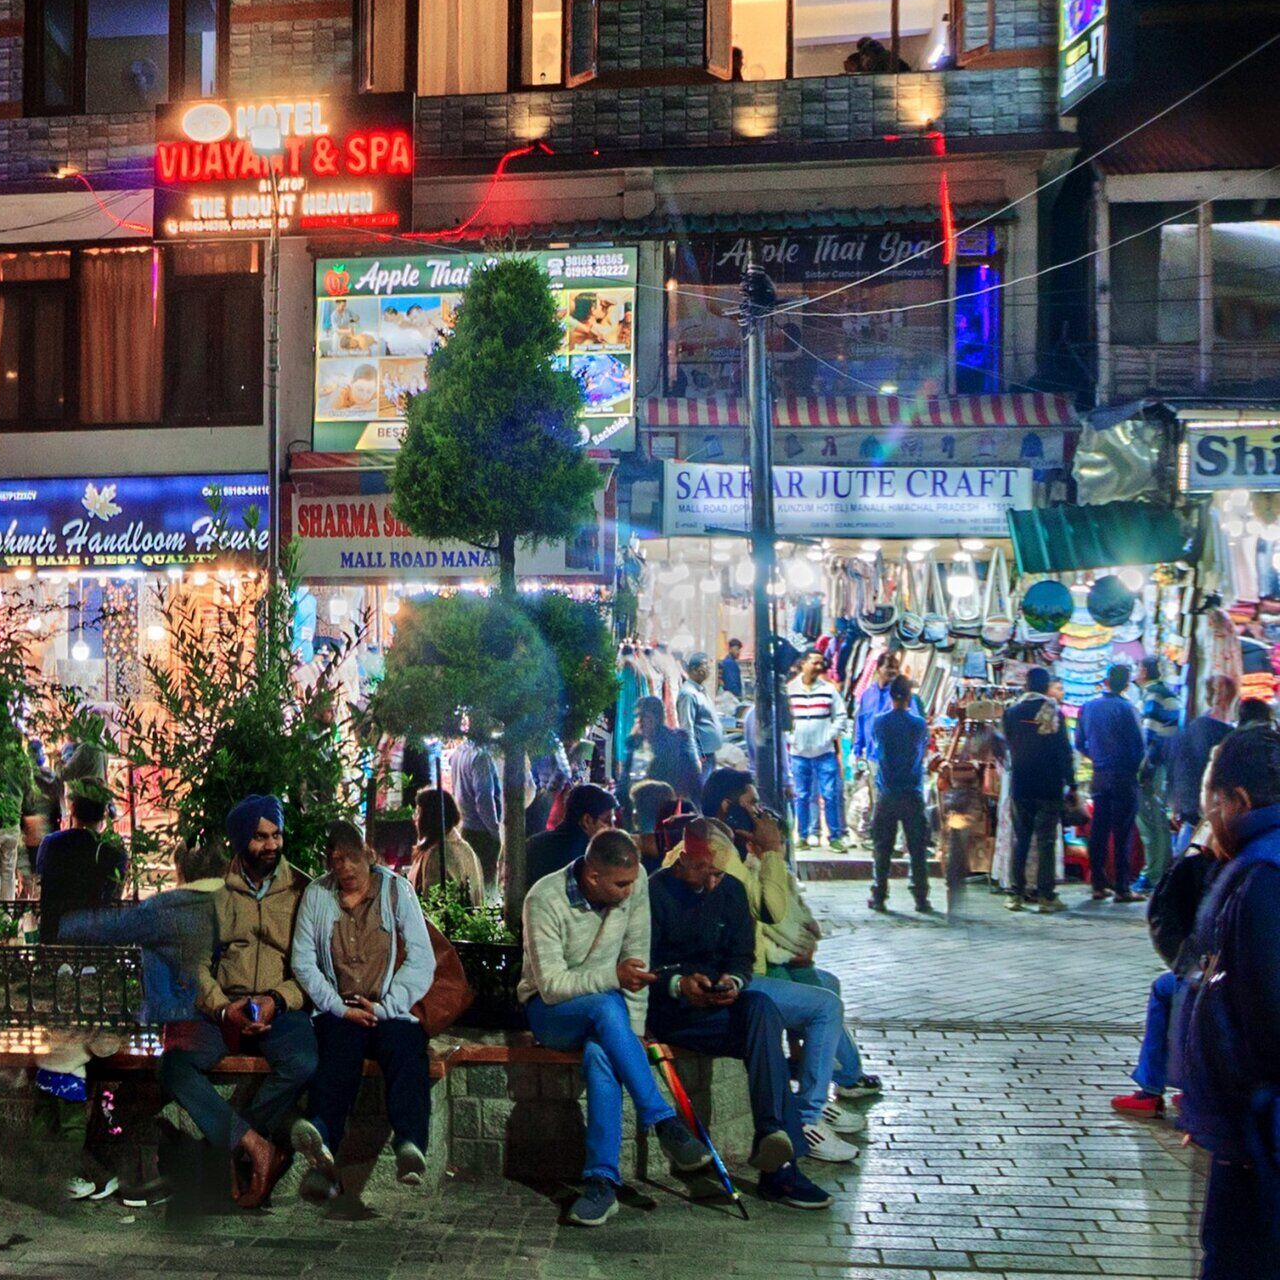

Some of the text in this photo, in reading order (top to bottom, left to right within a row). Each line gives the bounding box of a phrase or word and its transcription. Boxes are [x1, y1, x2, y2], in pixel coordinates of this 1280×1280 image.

[236, 102, 329, 138] HOTEL
[312, 135, 339, 176] &
[347, 131, 413, 175] SPA
[191, 196, 227, 219] THE
[879, 232, 932, 266] Spa
[354, 261, 419, 295] Apple
[590, 417, 630, 446] Backside
[816, 469, 897, 499] JUTE
[906, 469, 1018, 498] CRAFT
[62, 518, 188, 554] Handloom
[298, 503, 379, 538] SHARMA
[4, 554, 31, 566] WE
[36, 554, 81, 566] SALE
[93, 554, 137, 566] BEST
[340, 551, 386, 569] MALL
[390, 550, 438, 568] ROAD
